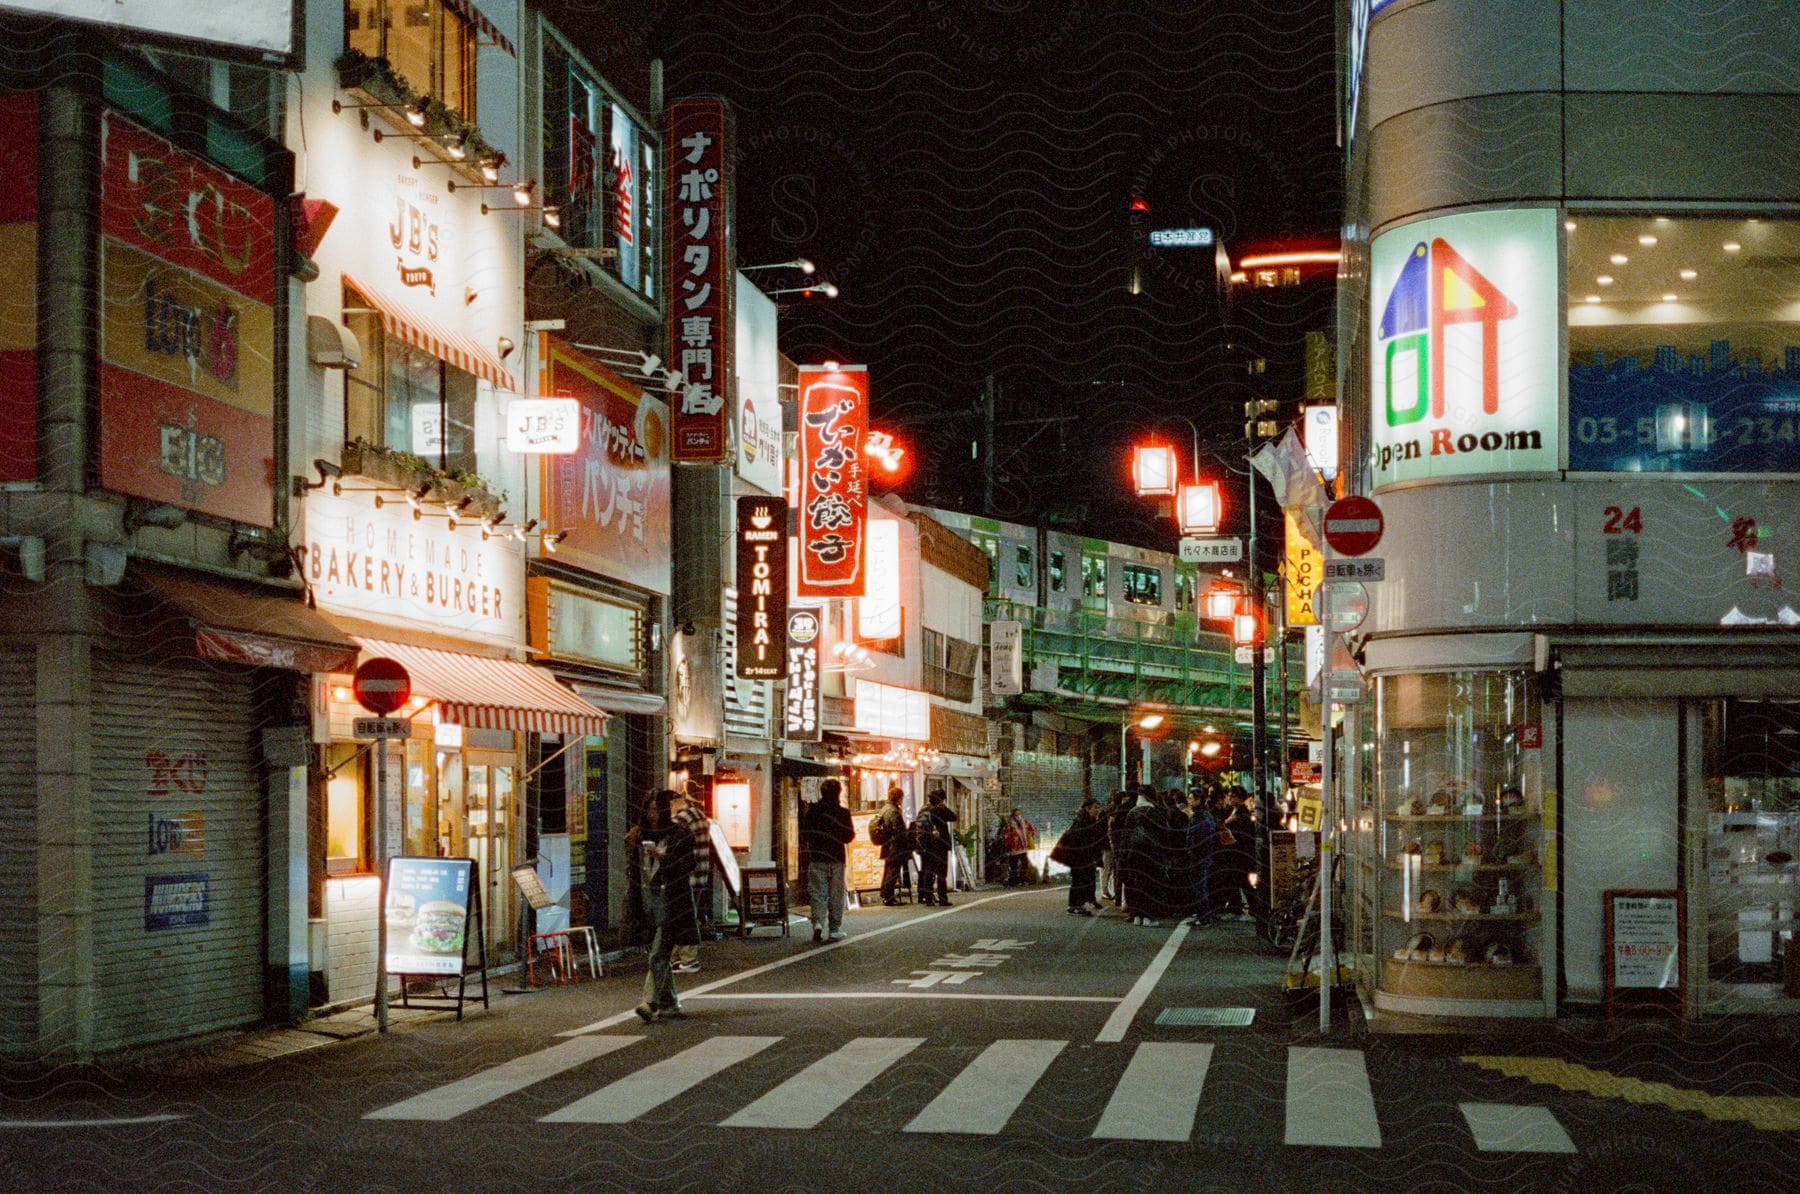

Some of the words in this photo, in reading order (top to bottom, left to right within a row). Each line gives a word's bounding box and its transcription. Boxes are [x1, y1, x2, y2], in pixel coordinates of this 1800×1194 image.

[389, 196, 440, 262] JB'S
[679, 131, 722, 416] ナポリタン専門店
[518, 414, 566, 434] JB'S
[1429, 427, 1543, 456] Room
[805, 400, 854, 564] でっかい餃子
[346, 515, 483, 577] HOMEMADE
[1183, 545, 1238, 557] 代々木商店街
[1326, 566, 1383, 578] 自転車を除く
[311, 542, 405, 598] BAKERY
[410, 572, 419, 597] &
[425, 571, 502, 619] BURGER
[752, 546, 771, 661] TOMIRAI
[1300, 549, 1313, 614] POCHA
